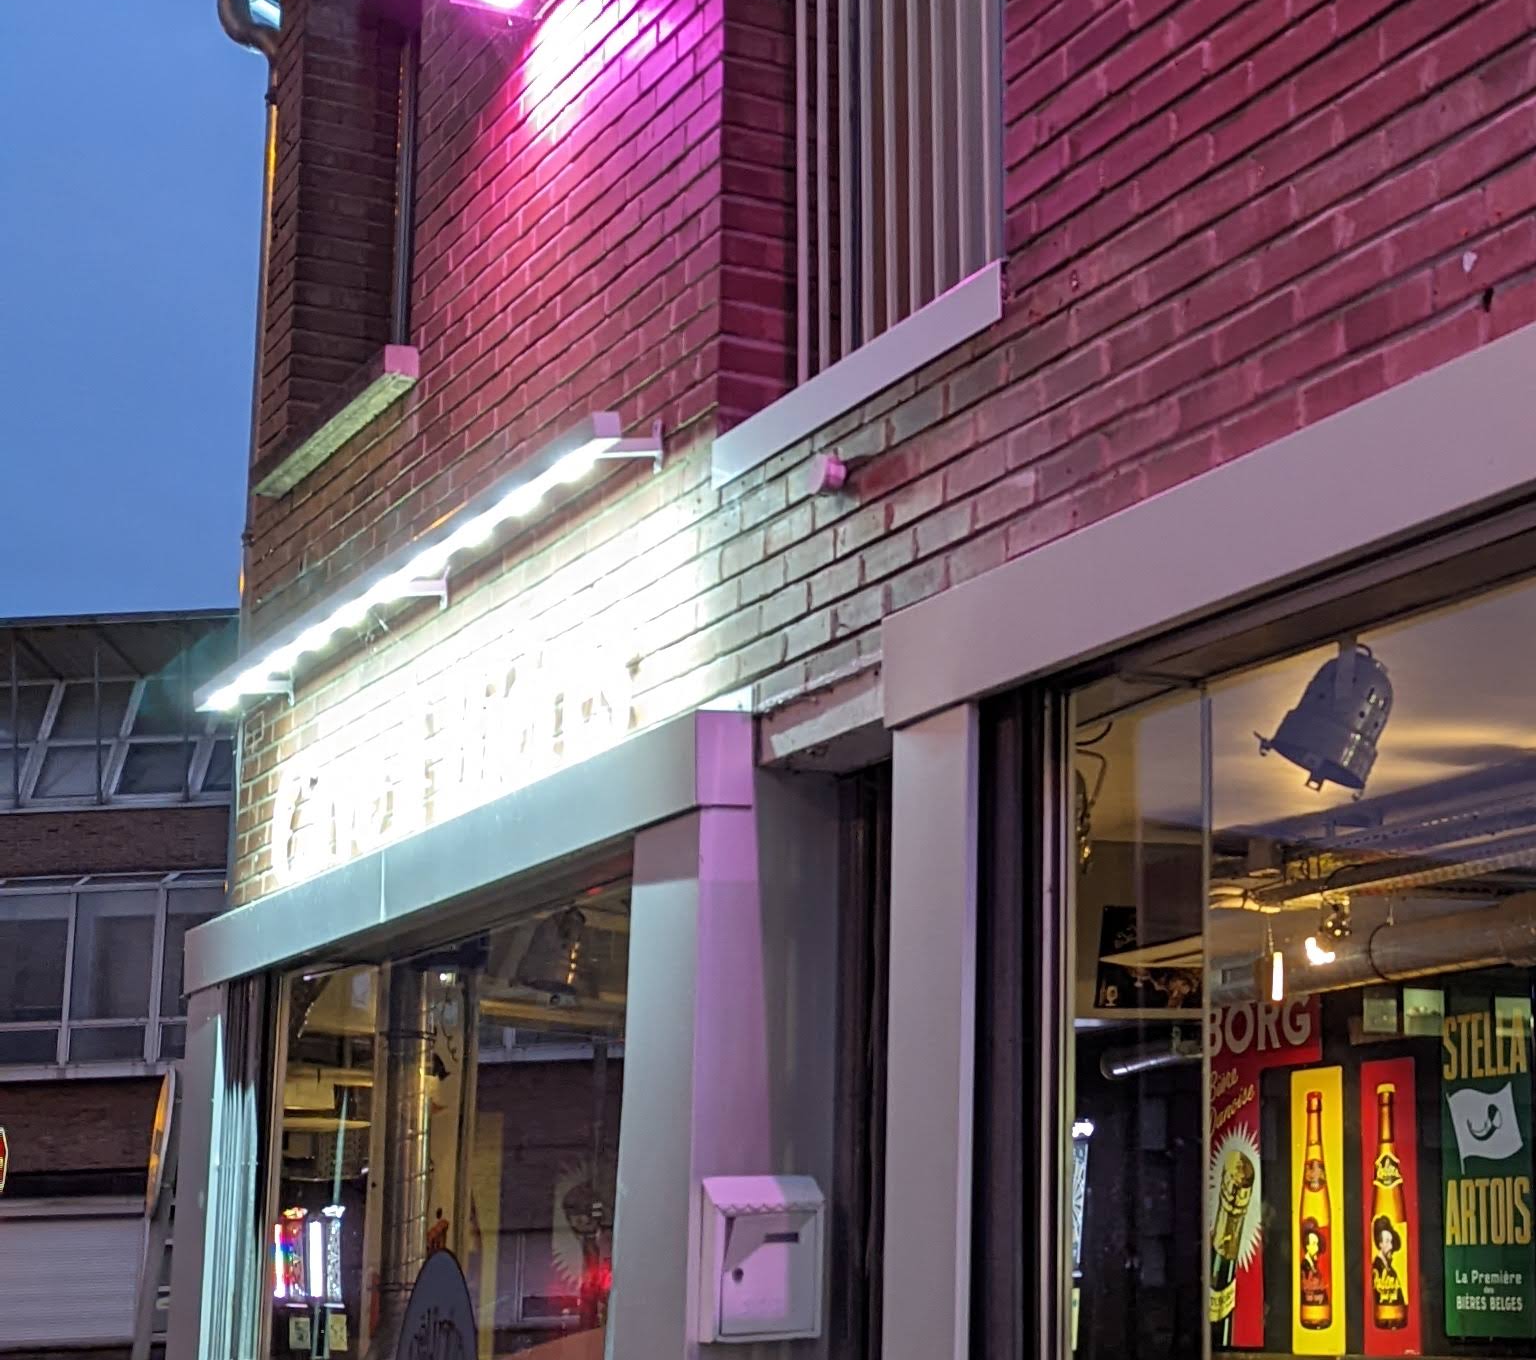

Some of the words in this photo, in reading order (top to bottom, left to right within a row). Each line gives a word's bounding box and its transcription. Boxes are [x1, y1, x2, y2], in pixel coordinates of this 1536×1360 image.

[1442, 1006, 1527, 1081] STELLA
[1446, 1176, 1531, 1246] ARTOIS
[1455, 1269, 1469, 1285] La
[1471, 1269, 1522, 1286] Première
[1456, 1293, 1488, 1312] BIÈRES
[1489, 1294, 1523, 1312] BELGES
